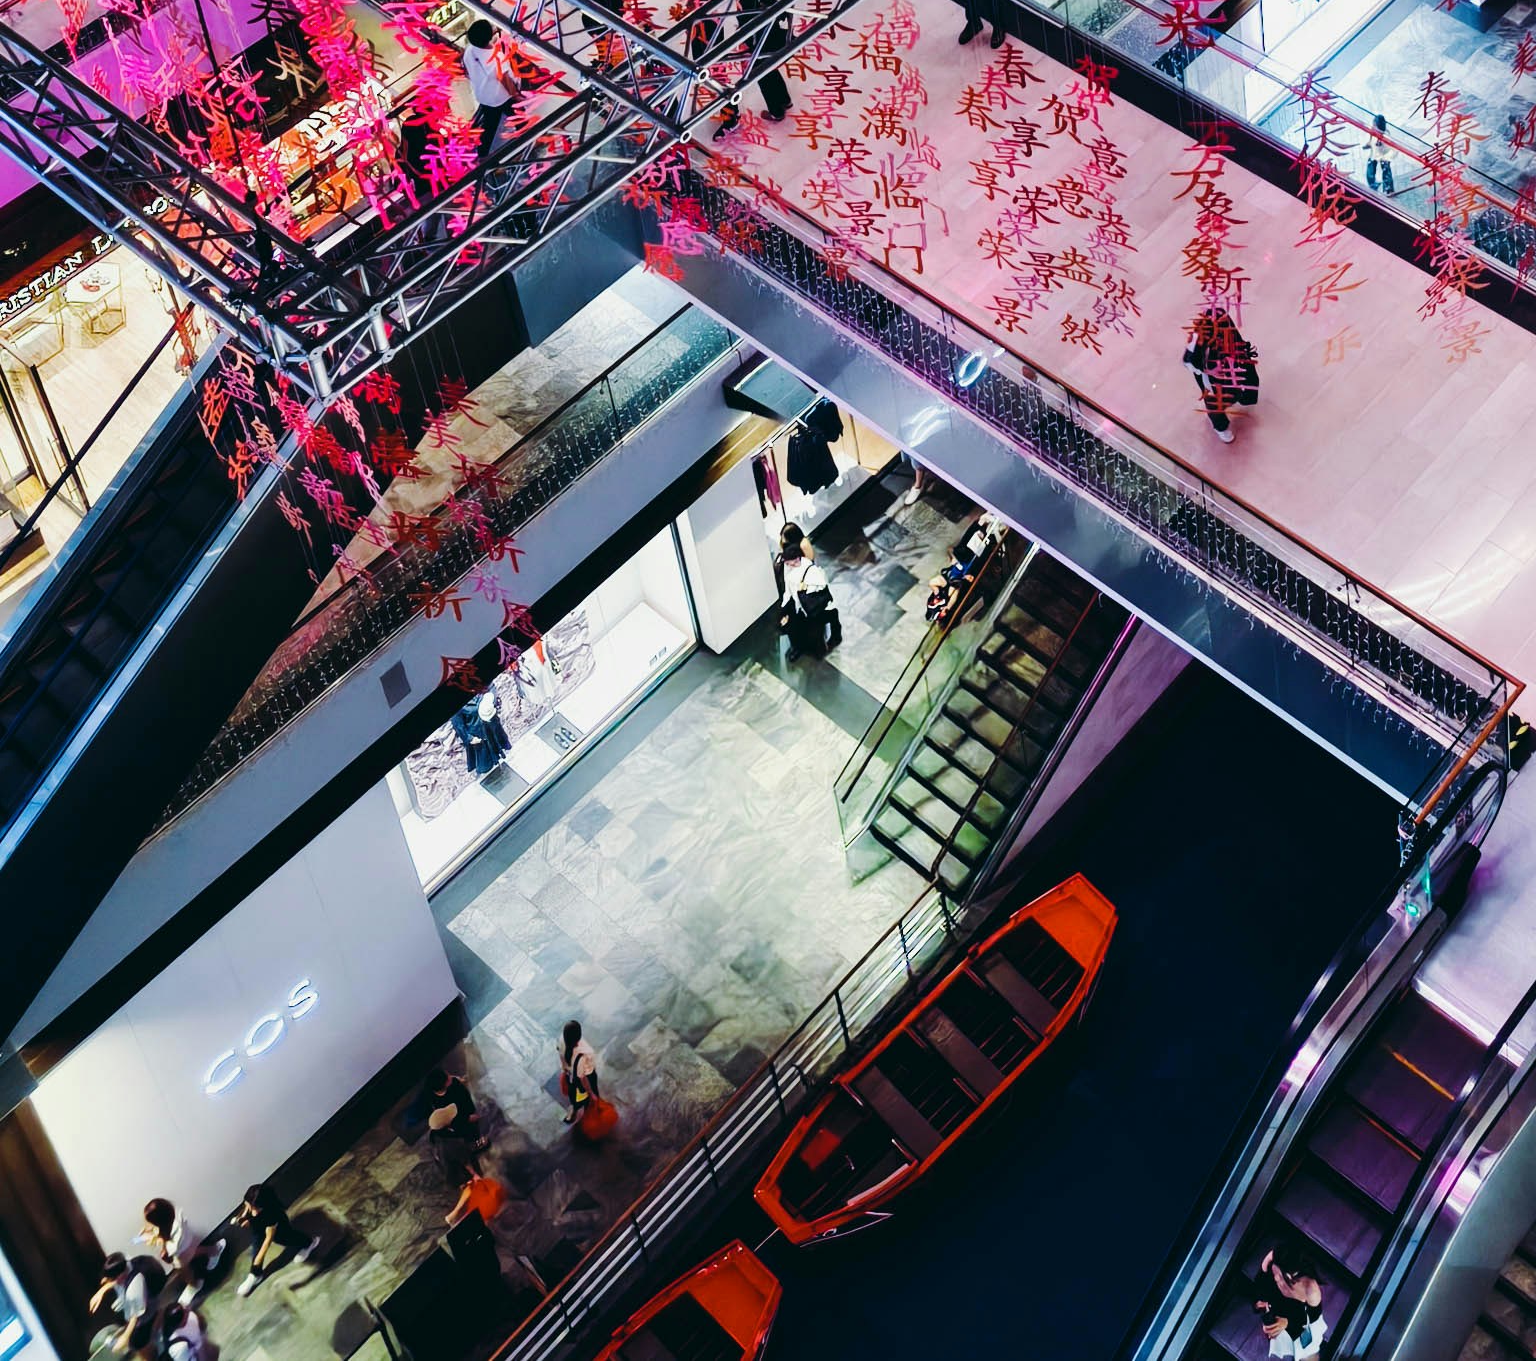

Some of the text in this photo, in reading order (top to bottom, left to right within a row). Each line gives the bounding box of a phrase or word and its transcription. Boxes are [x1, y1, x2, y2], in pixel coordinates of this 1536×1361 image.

[849, 33, 903, 76] 福
[994, 44, 1045, 88] 春
[818, 65, 862, 105] 享
[859, 107, 907, 147] 满
[955, 85, 1005, 132] 春
[1038, 94, 1083, 144] 贺
[788, 111, 833, 150] 享
[1005, 117, 1049, 157] 享
[828, 138, 876, 174] 荣
[986, 138, 1032, 177] 享
[1085, 137, 1127, 178] 意
[801, 180, 848, 217] 荣
[873, 175, 922, 209] 临
[968, 160, 1010, 200] 享
[1046, 174, 1094, 219] 意
[840, 200, 886, 236] 景
[1013, 186, 1060, 224] 荣
[879, 243, 923, 274] 门
[977, 229, 1023, 271] 荣
[1020, 250, 1064, 289] 景
[984, 295, 1032, 335] 景
[1100, 274, 1142, 317] 然
[1060, 314, 1102, 355] 然
[204, 978, 319, 1095] COS
